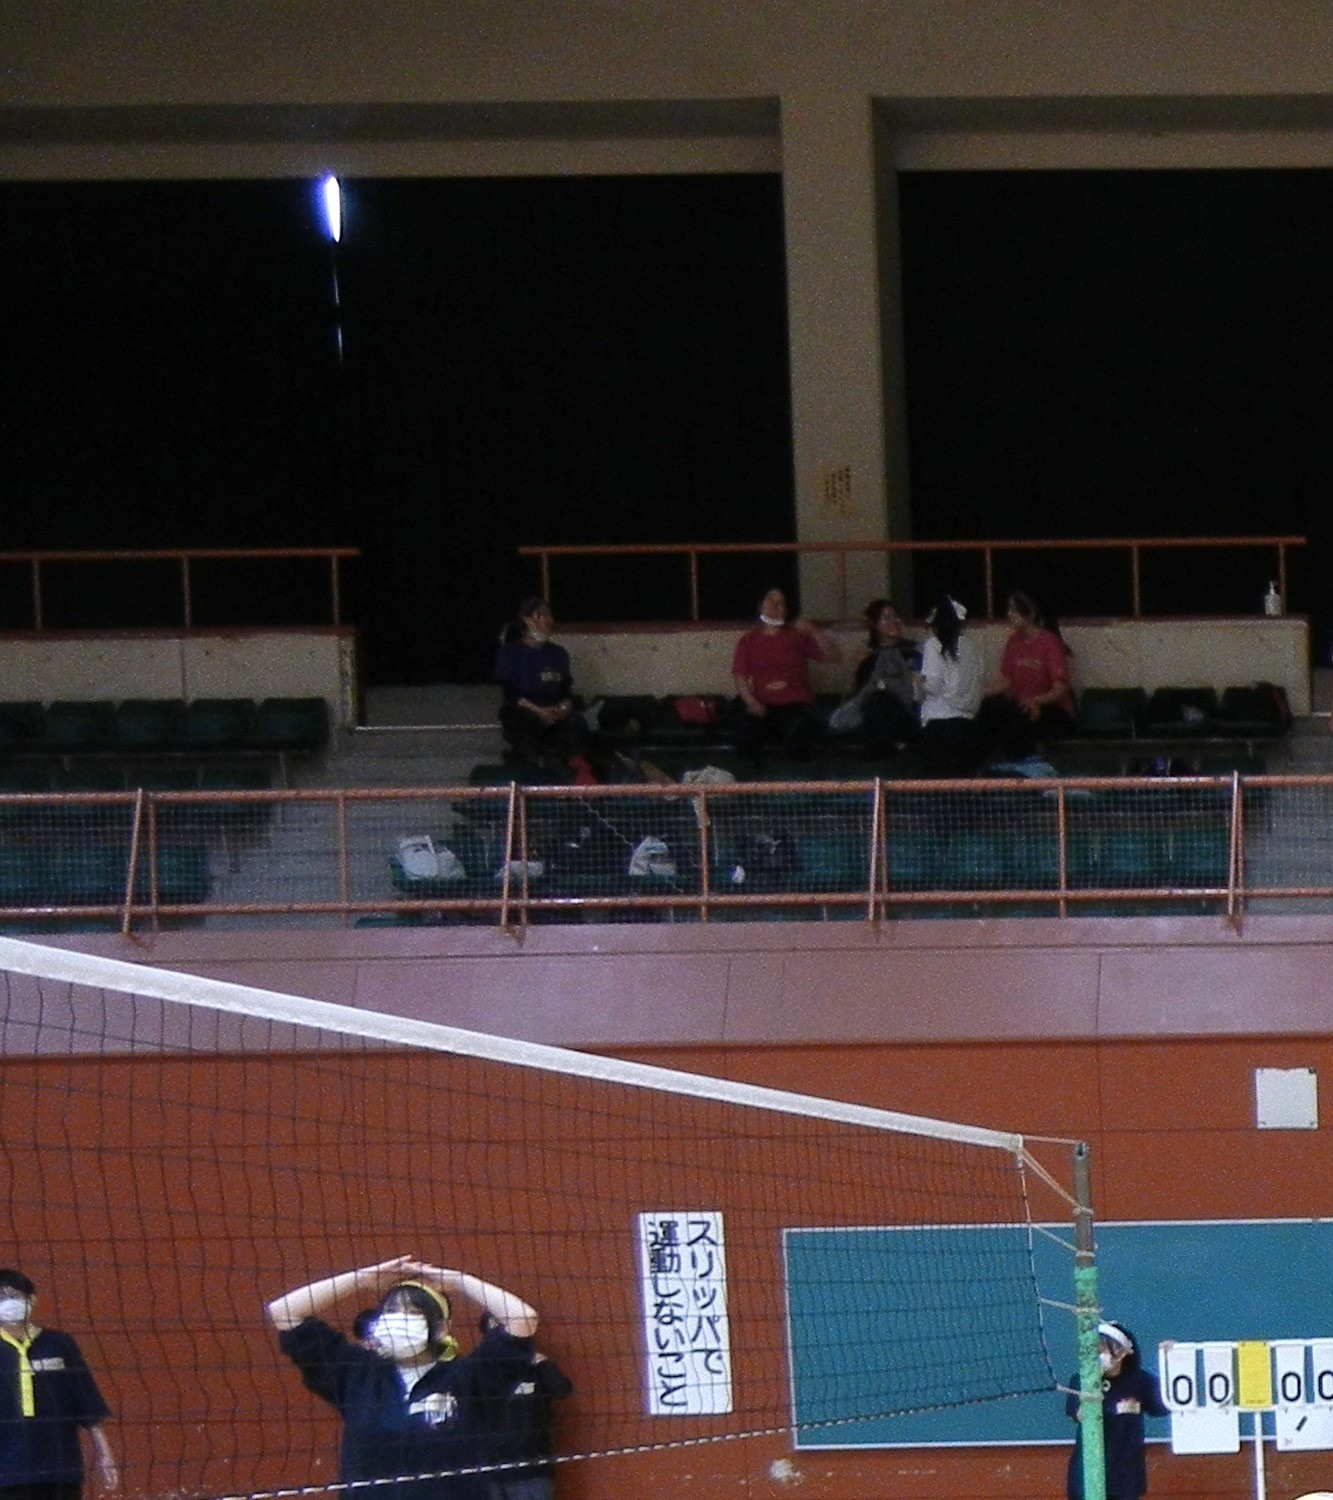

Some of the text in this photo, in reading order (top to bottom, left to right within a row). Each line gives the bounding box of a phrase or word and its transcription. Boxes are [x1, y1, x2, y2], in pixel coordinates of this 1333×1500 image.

[649, 1220, 687, 1406] 運動しないこと
[687, 1220, 723, 1374] スリッパで
